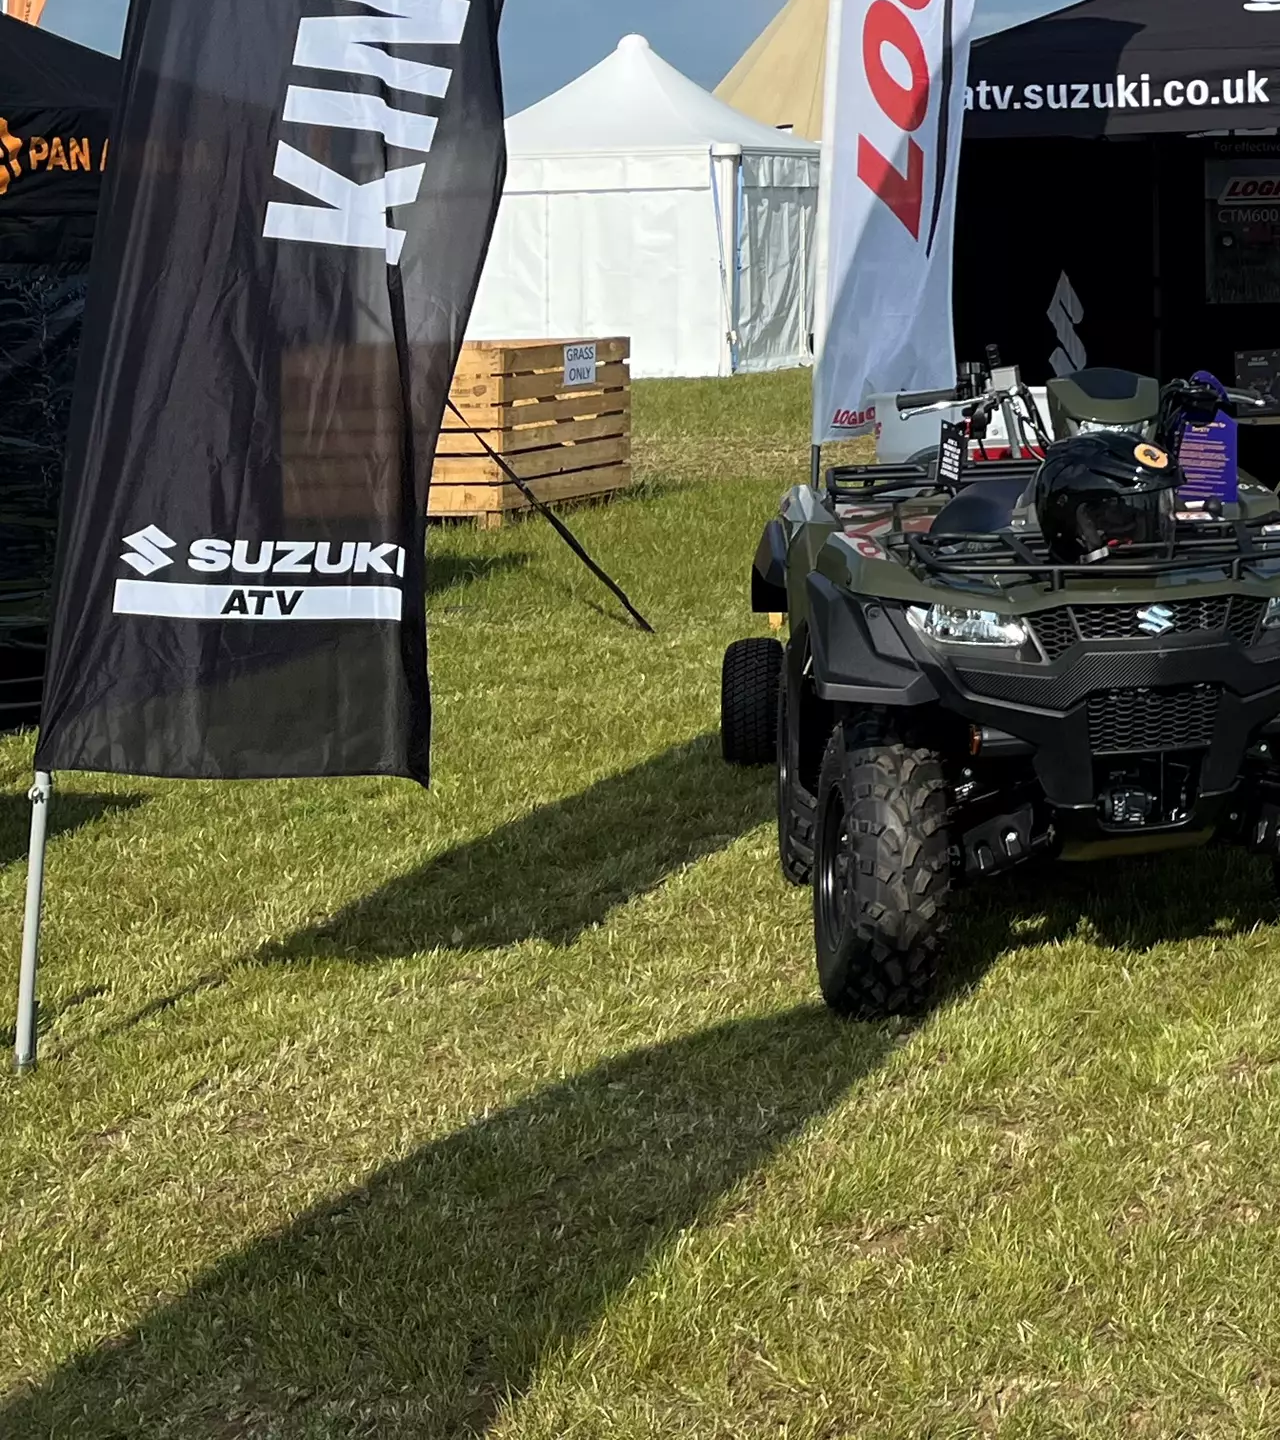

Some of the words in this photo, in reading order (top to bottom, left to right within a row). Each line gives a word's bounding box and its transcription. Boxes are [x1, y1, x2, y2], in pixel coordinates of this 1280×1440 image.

[962, 69, 1270, 111] atv.suzuki.co.uk
[29, 137, 91, 171] PAN
[1218, 209, 1279, 223] CTM600
[566, 346, 594, 361] GRASS
[569, 367, 592, 381] ONLY
[187, 538, 406, 578] SUZUKI
[220, 589, 304, 616] ATV
